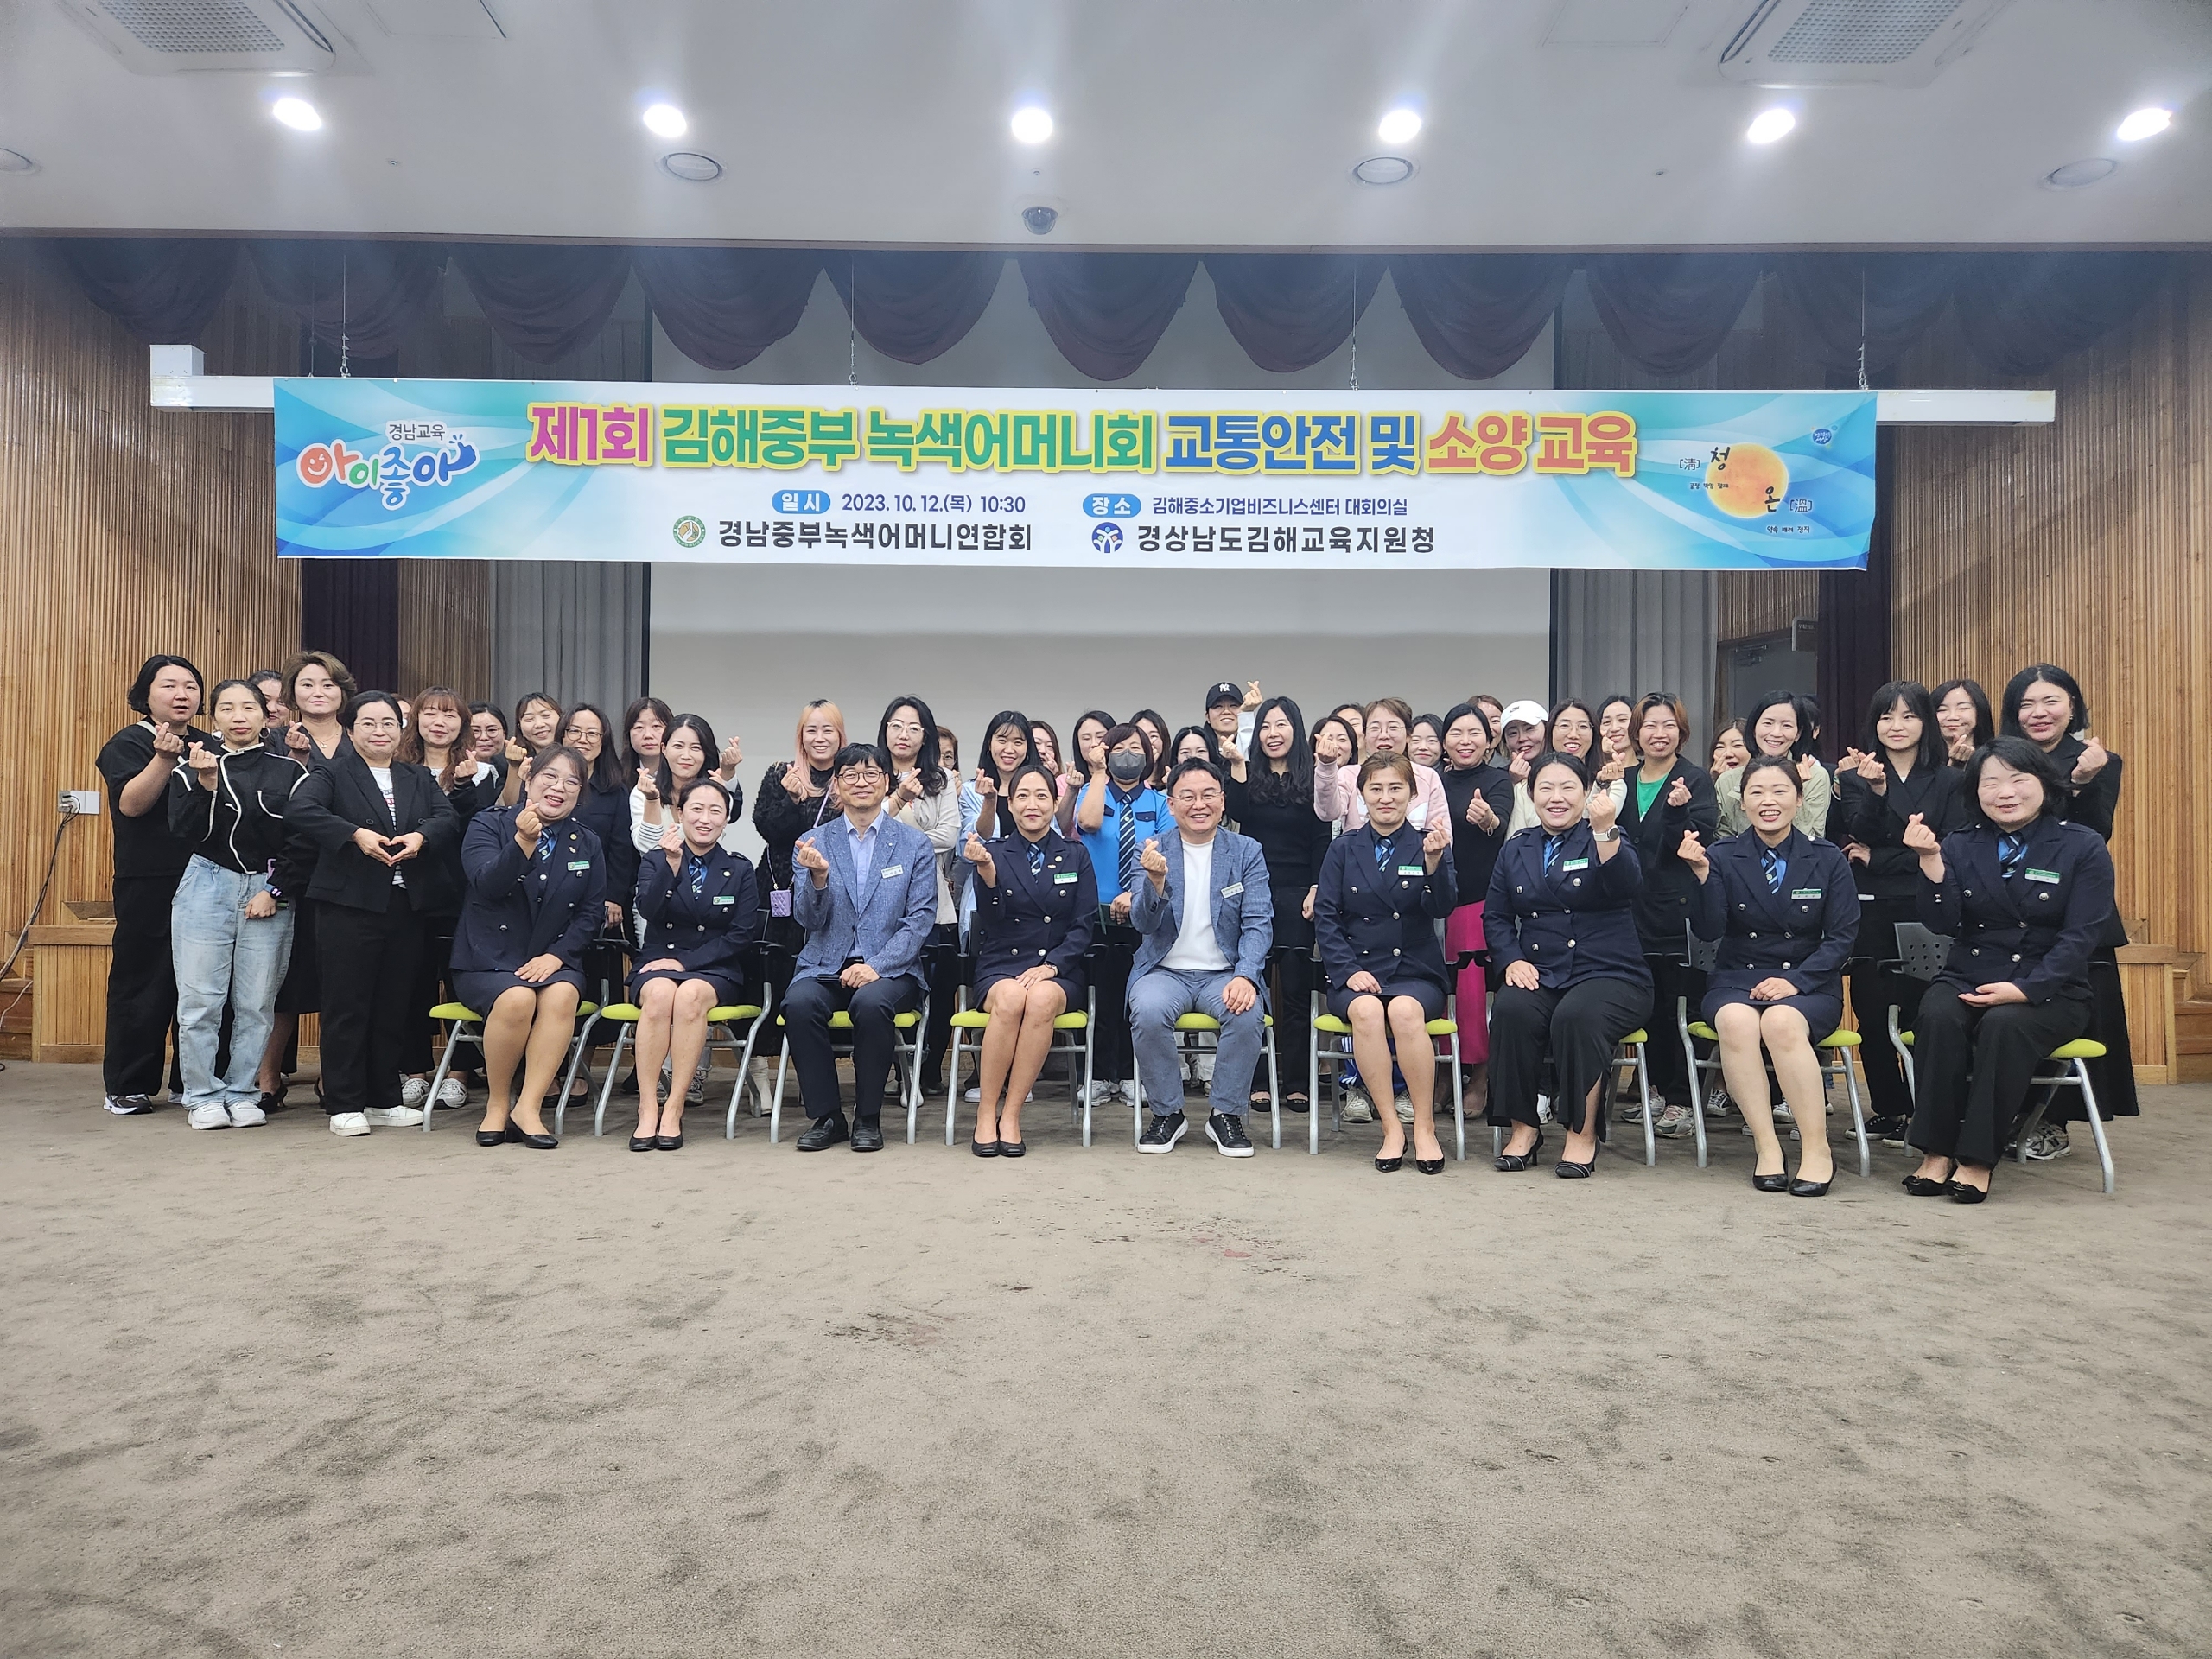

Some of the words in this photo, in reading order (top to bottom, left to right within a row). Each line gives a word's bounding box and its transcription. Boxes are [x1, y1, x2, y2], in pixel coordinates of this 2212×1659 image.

[388, 423, 447, 442] 경남교육
[530, 405, 649, 463] 제1회
[663, 408, 856, 467] 김해중부
[867, 410, 1154, 469] 녹색어머니회
[1166, 413, 1357, 471] 교통안전
[1370, 415, 1417, 472] 및
[1427, 415, 1529, 472] 소양
[1536, 415, 1634, 474] 교육
[1710, 446, 1731, 471] 청
[299, 442, 477, 510] 아이좋아
[980, 495, 1026, 514] 10:30
[1152, 496, 1340, 517] 김해중소기업비즈니스센터
[1344, 497, 1408, 517] 대회의실
[1764, 486, 1781, 513] 온
[718, 519, 1032, 551] 경남중부녹색어머니연합회
[1136, 524, 1434, 554] 경상남도김해교육지원청
[1796, 525, 1810, 534] 정직
